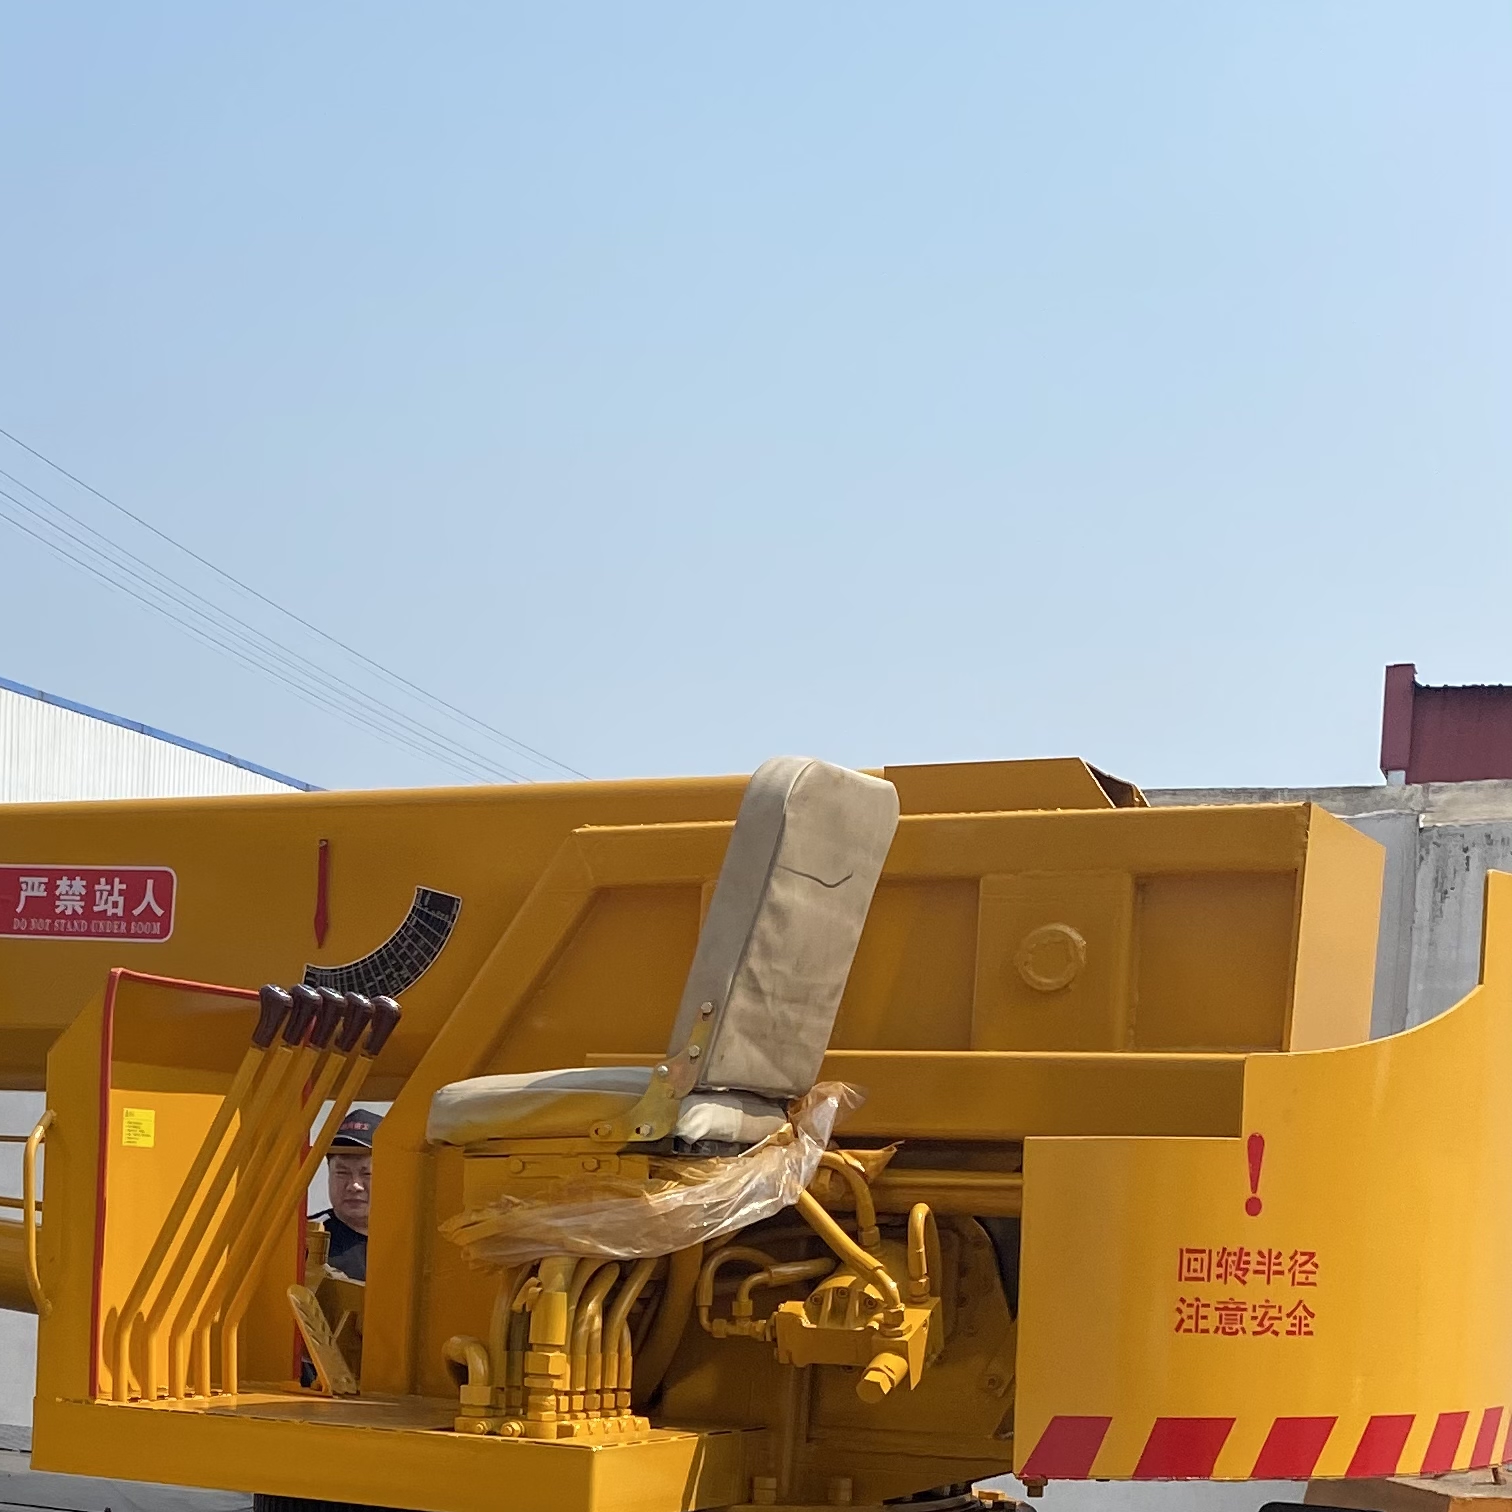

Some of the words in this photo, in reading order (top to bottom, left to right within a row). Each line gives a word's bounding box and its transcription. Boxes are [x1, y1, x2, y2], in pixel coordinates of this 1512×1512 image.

[15, 876, 166, 917] 严禁站人
[12, 917, 28, 930] DO
[1177, 1247, 1320, 1287] 回转半径
[1174, 1296, 1316, 1337] 注意安全
